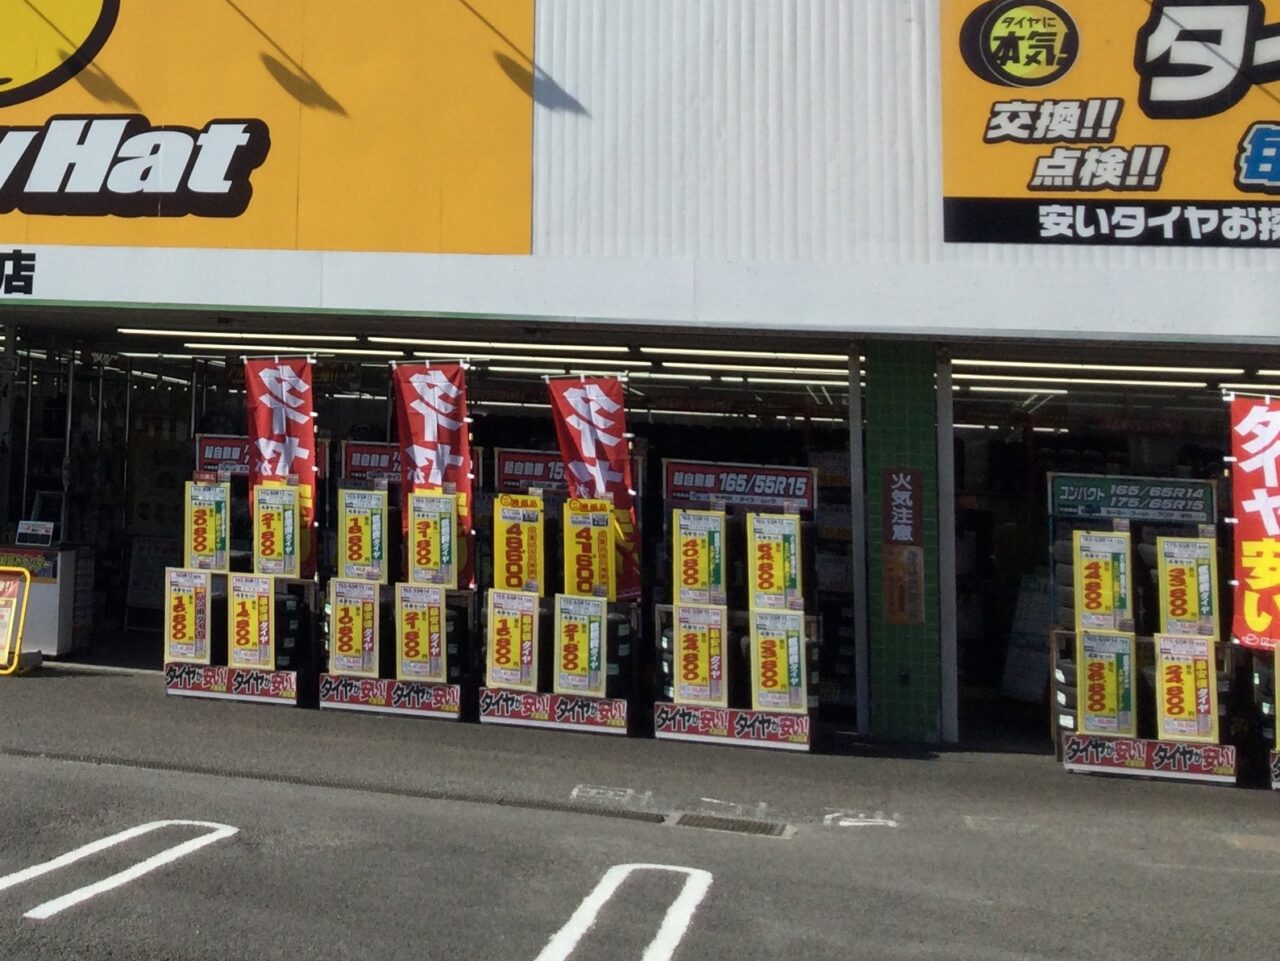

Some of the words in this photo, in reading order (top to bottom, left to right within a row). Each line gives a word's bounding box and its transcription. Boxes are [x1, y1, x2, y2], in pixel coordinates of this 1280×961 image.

[1001, 16, 1057, 29] タイヤに
[1145, 4, 1280, 102] タ
[986, 100, 1120, 140] 交換!!
[1030, 145, 1165, 187] 点検!!
[547, 461, 566, 480] 15
[719, 472, 807, 496] 165/55R15
[1059, 485, 1105, 501] コンパクト
[1109, 485, 1205, 499] 165/65R14
